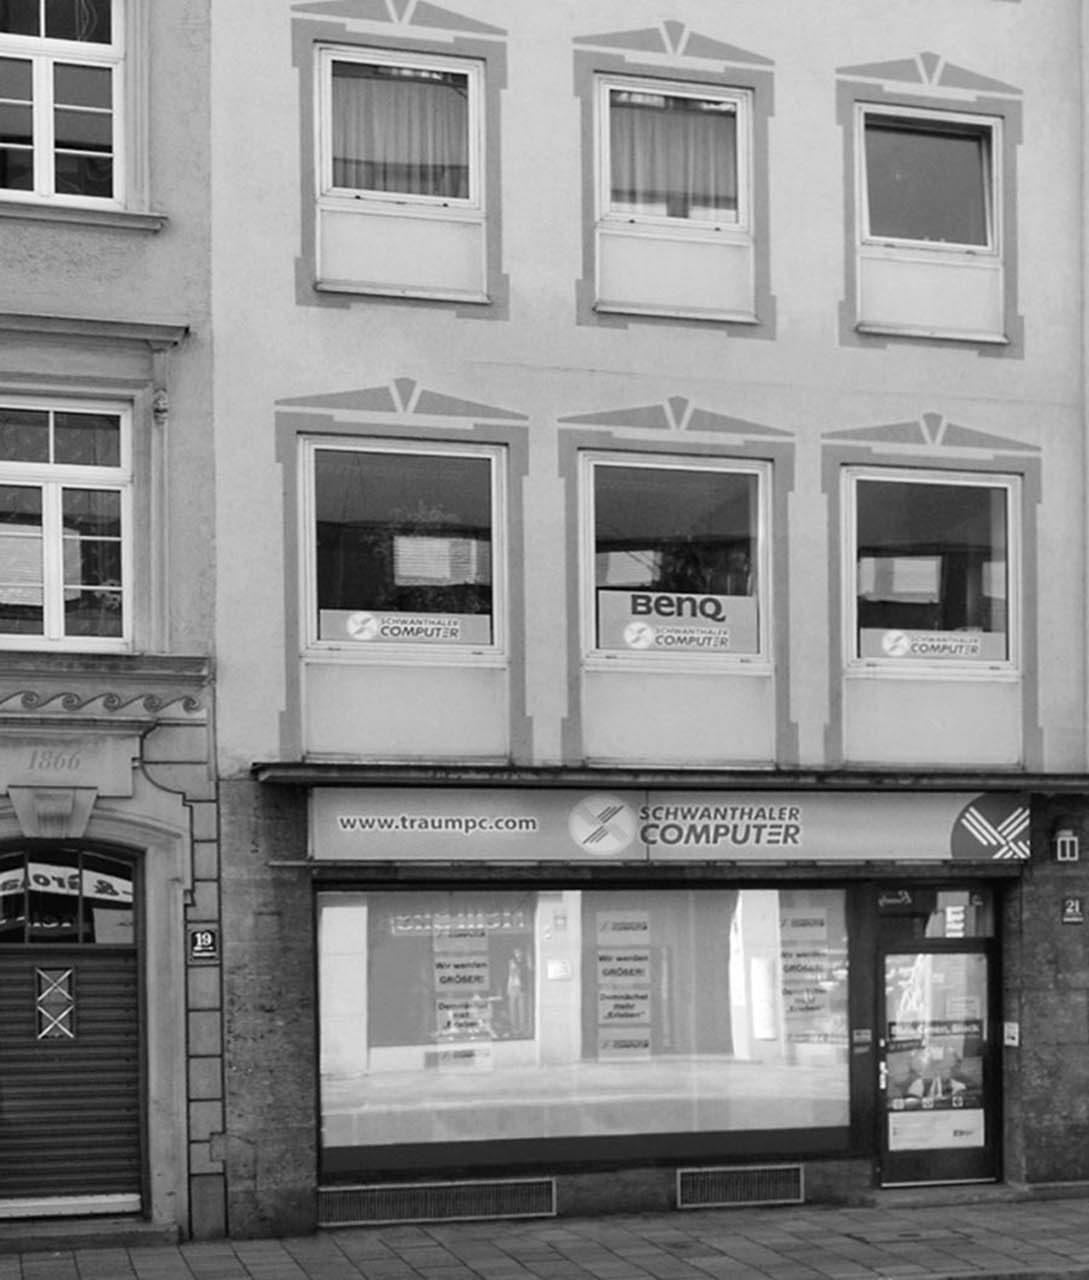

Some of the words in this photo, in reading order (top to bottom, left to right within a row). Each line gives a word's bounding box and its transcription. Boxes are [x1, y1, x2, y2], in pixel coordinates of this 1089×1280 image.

[631, 594, 726, 622] BenQ
[380, 626, 460, 638] COMPUTER
[27, 749, 81, 770] 1866
[639, 805, 801, 821] SCHWANTHALER
[338, 815, 538, 834] www.traumpc.com
[639, 824, 801, 845] COMPUTER
[194, 931, 213, 946] 19
